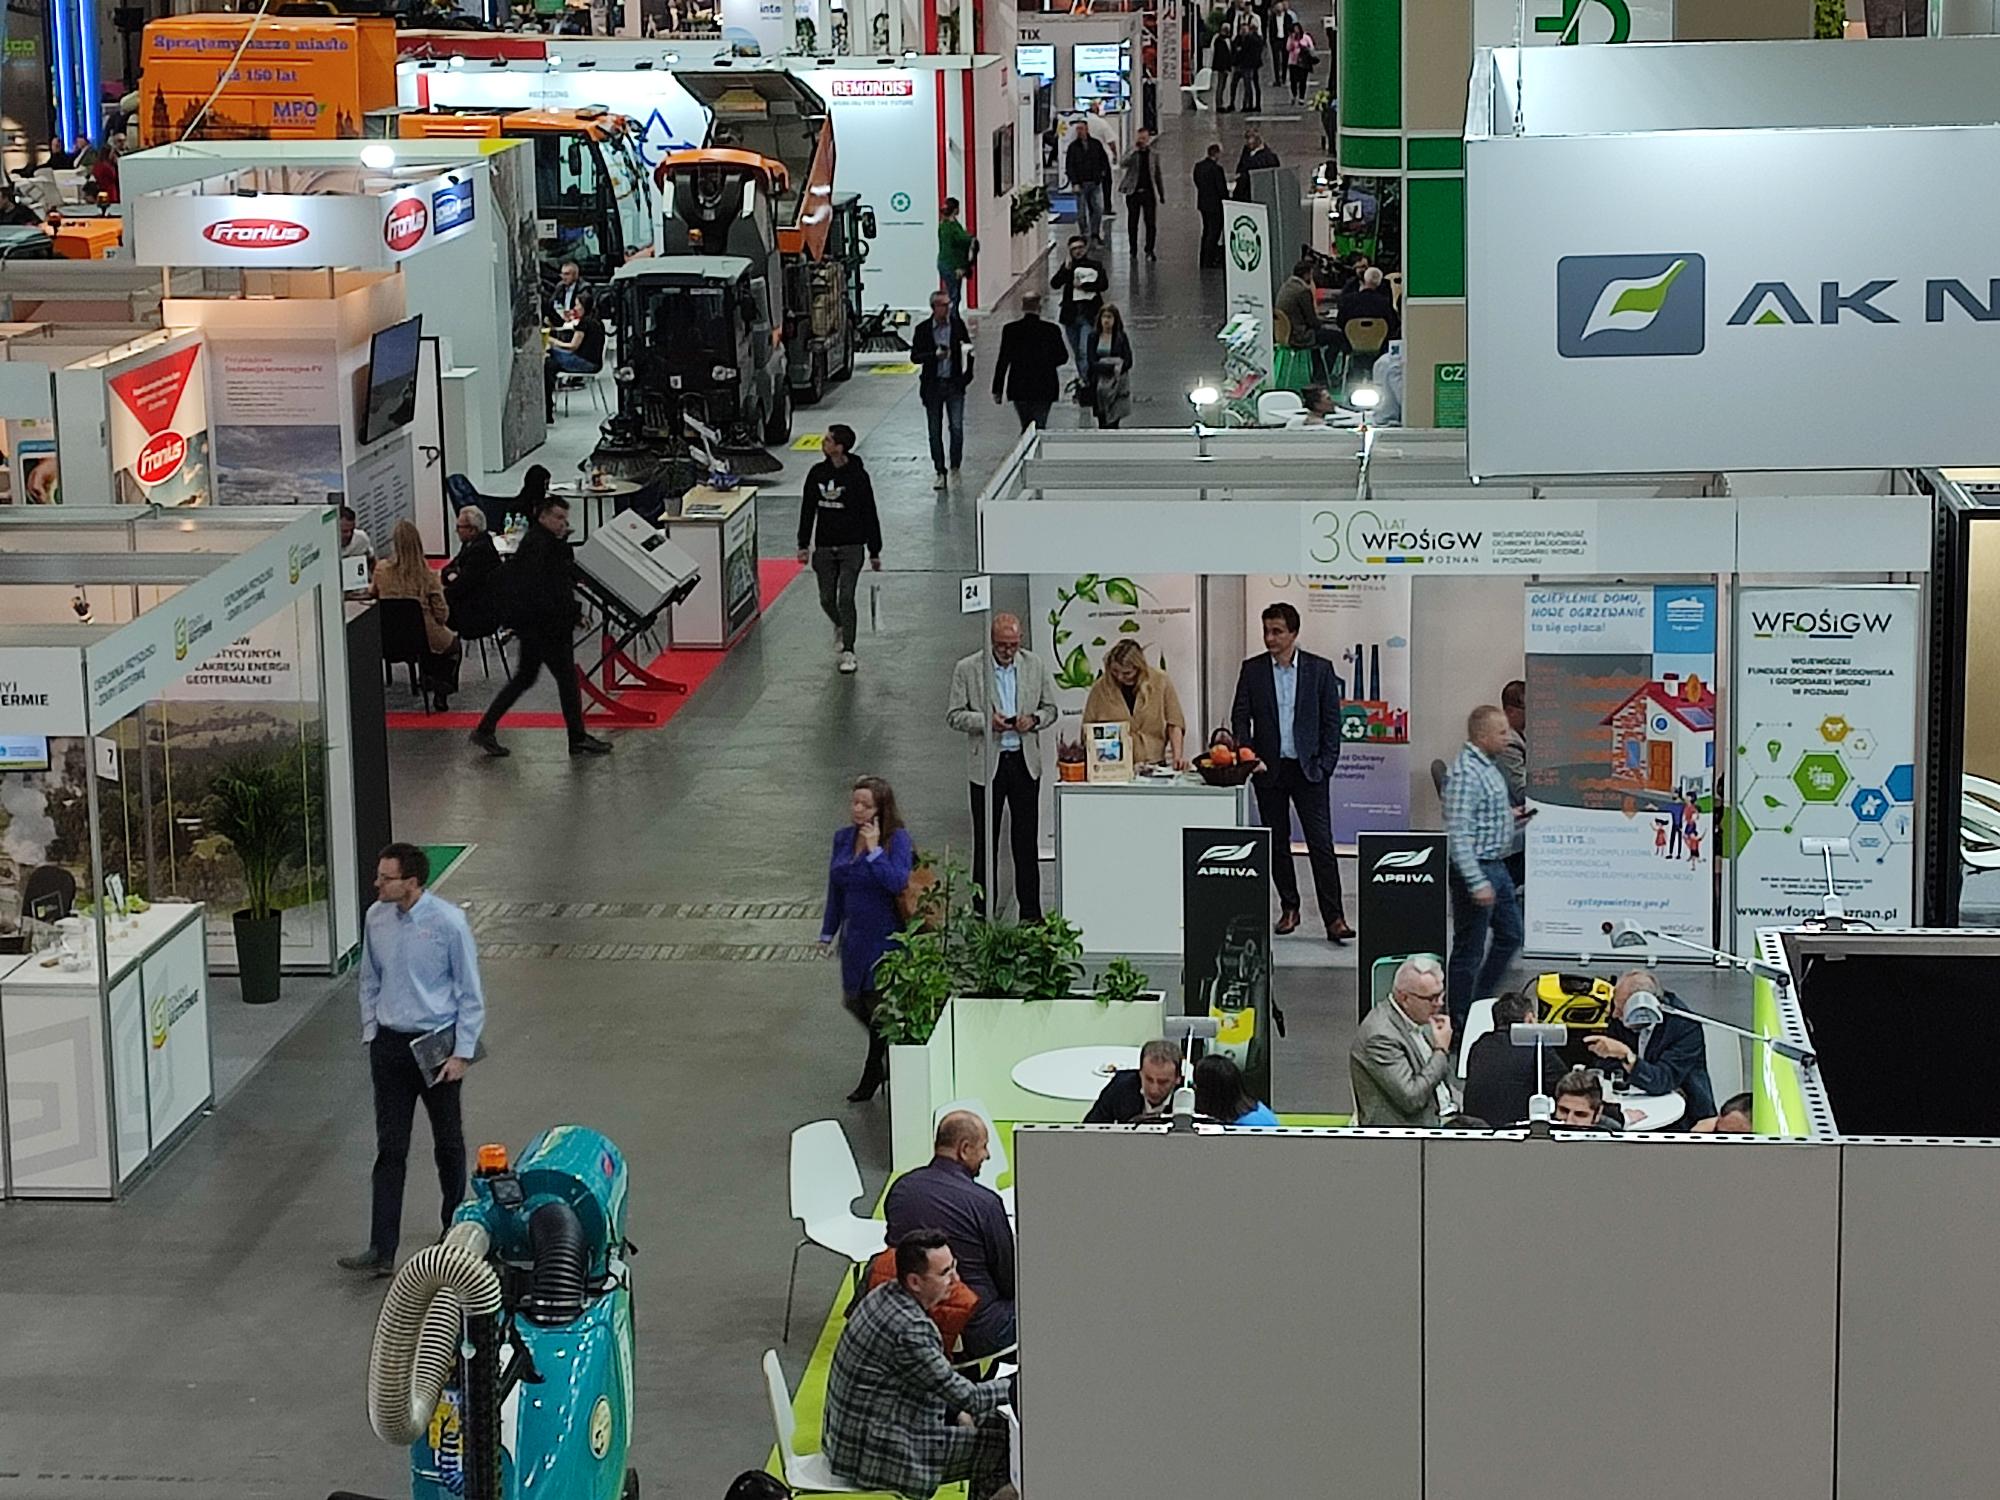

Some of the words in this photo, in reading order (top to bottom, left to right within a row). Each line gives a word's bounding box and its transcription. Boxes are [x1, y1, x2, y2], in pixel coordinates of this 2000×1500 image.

[277, 68, 297, 81] lat
[833, 81, 906, 95] REMONDIS
[273, 101, 317, 117] MPO
[211, 223, 301, 240] Fronius
[387, 209, 425, 241] Fronius
[141, 439, 182, 476] Fronius
[1531, 593, 1597, 604] OCIEPLENIE
[1531, 607, 1564, 617] NOWE
[1569, 607, 1646, 617] OGRZEWANIE
[1752, 609, 1892, 633] WFOŚiGW
[1198, 867, 1258, 877] APRIVA
[1373, 873, 1434, 883] APRIVA
